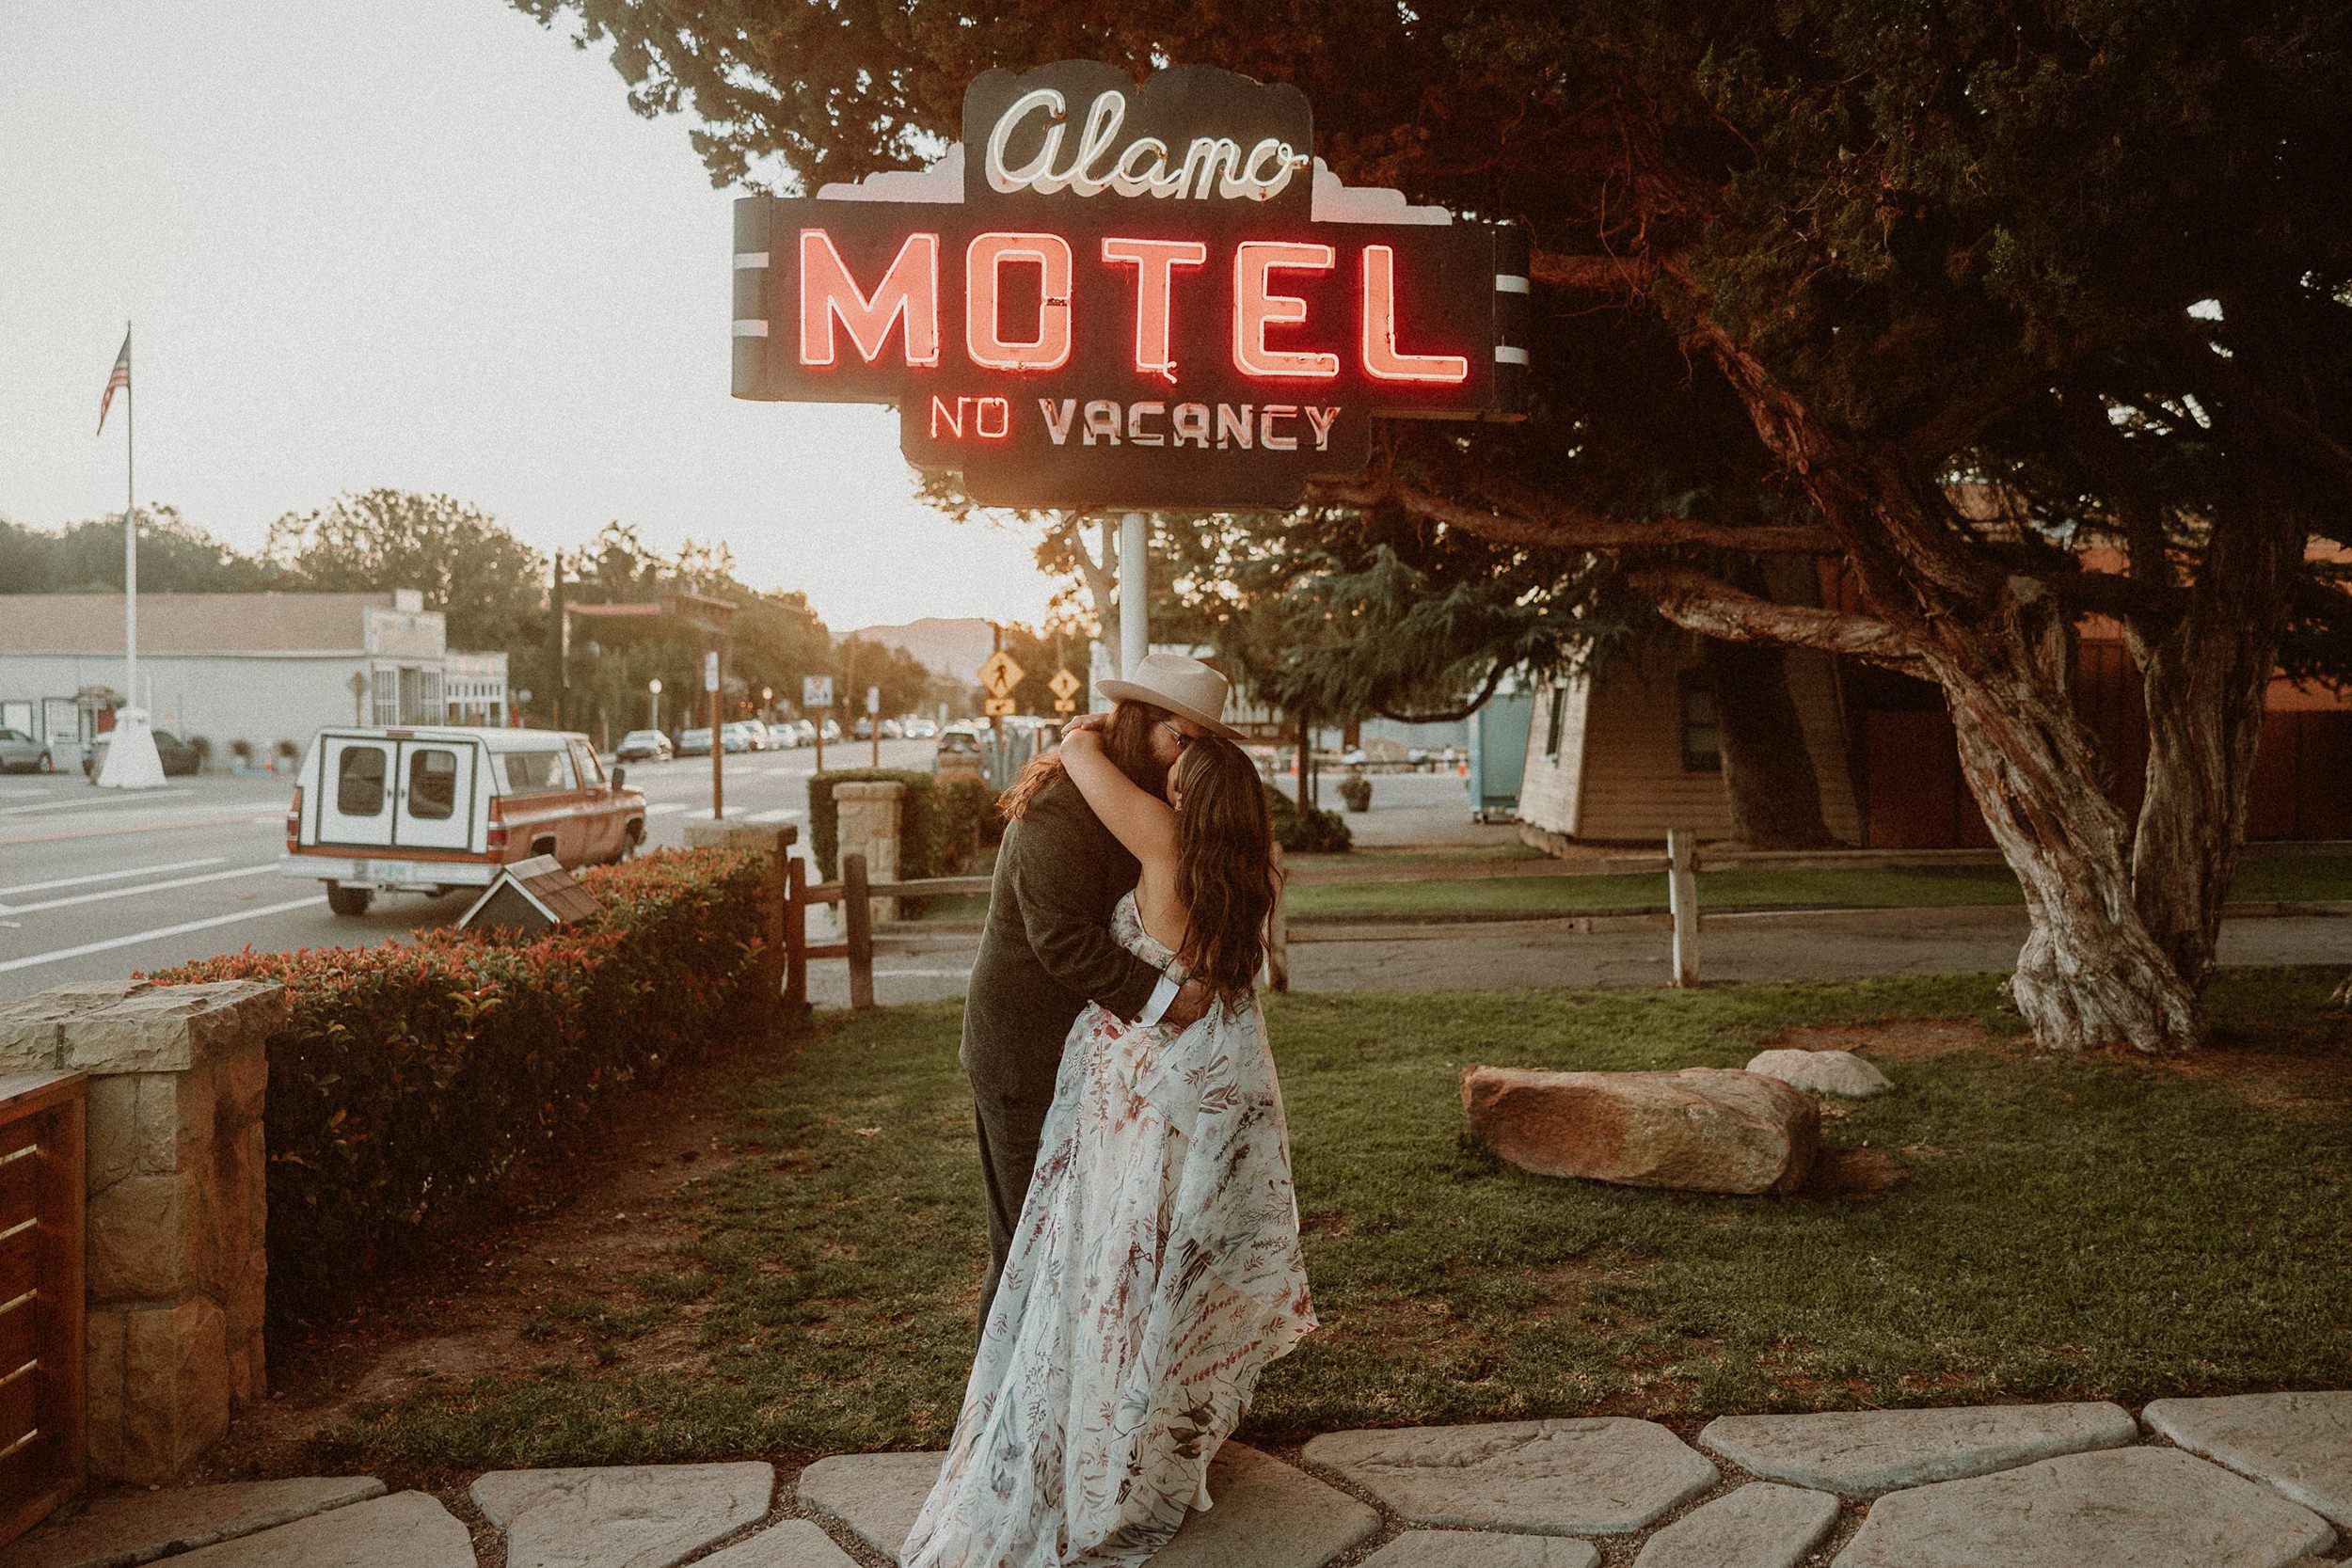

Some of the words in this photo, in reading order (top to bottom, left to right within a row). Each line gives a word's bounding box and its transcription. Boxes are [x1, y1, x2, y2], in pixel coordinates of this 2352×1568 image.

[985, 88, 1309, 200] Alamo
[799, 228, 1469, 383] MOTEL
[930, 394, 1009, 438] NO
[1038, 398, 1341, 451] VACANCY
